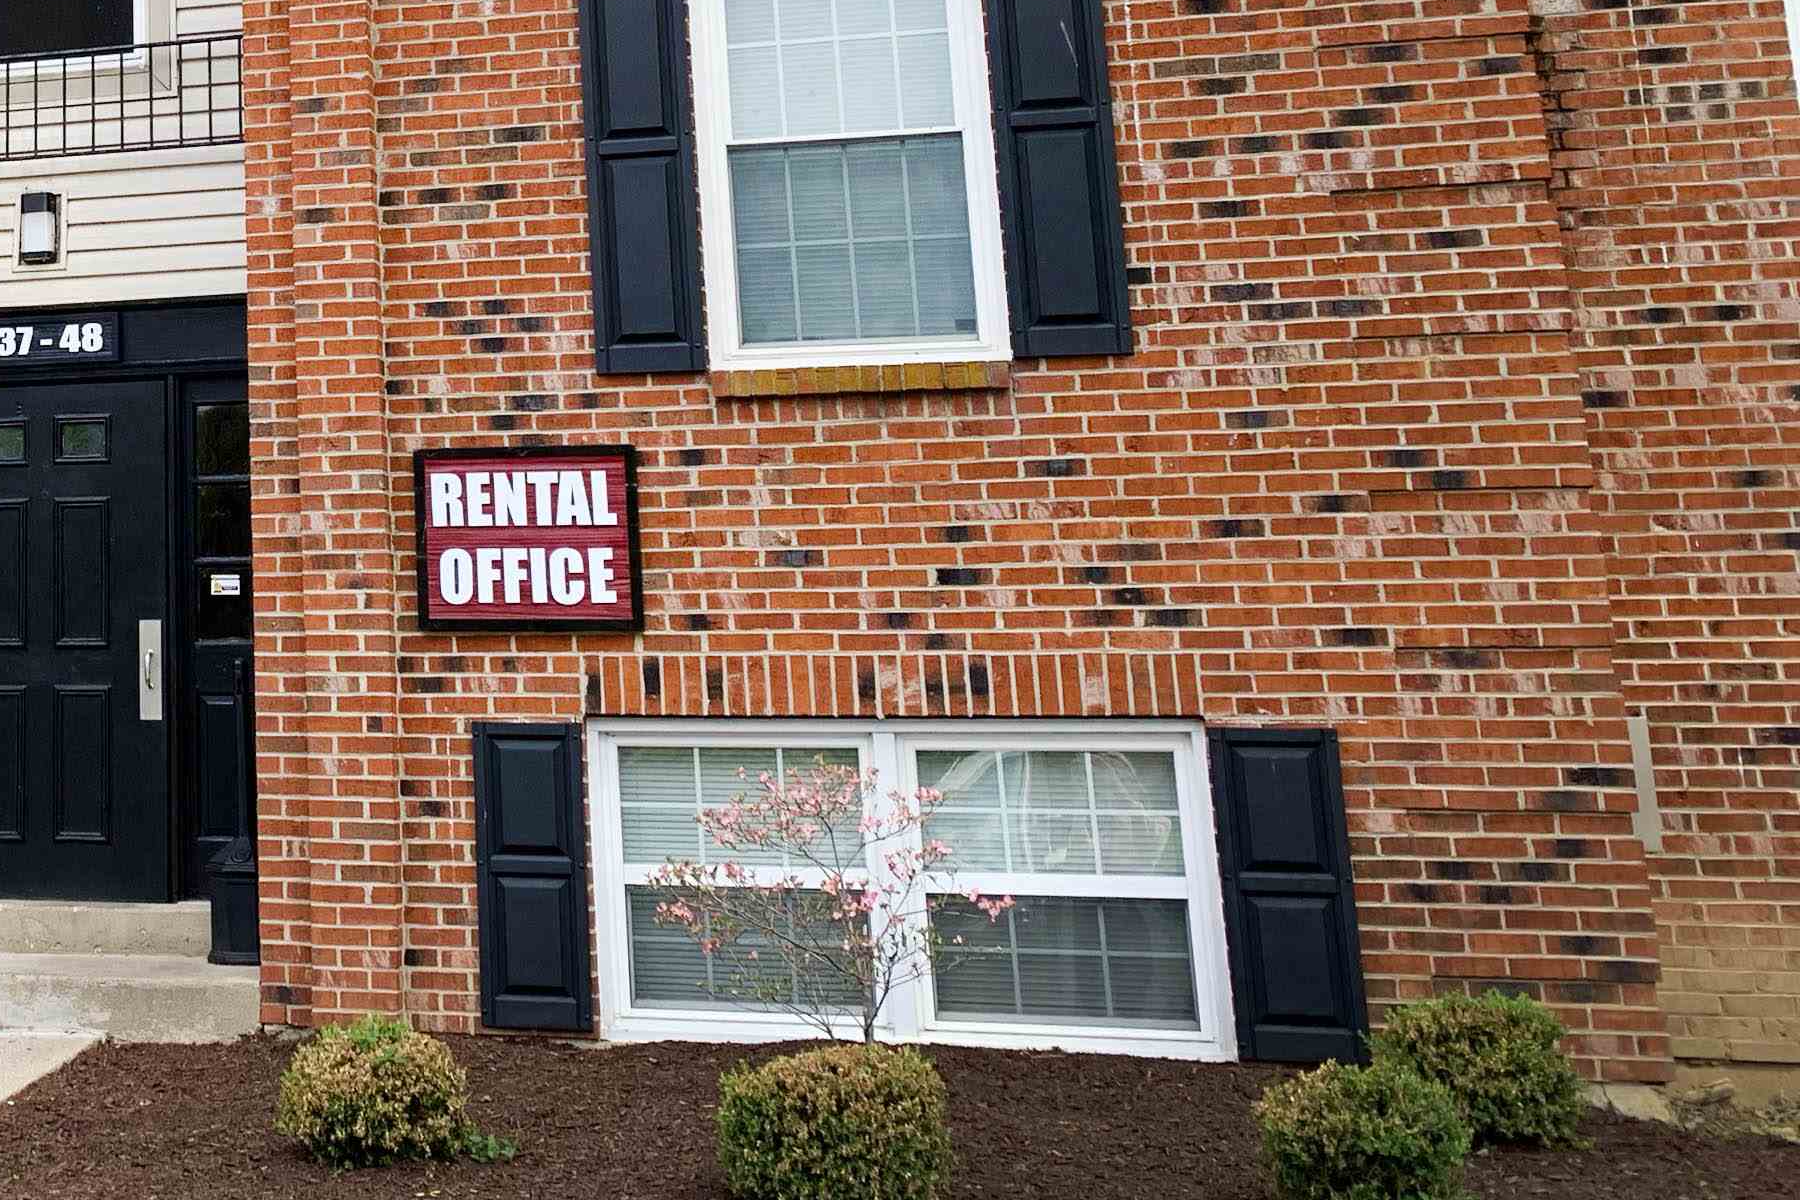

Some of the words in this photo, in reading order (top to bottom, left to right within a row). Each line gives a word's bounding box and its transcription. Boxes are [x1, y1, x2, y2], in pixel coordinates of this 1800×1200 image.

[58, 322, 104, 353] 48
[430, 470, 618, 528] RENTAL
[439, 547, 618, 606] OFFICE
